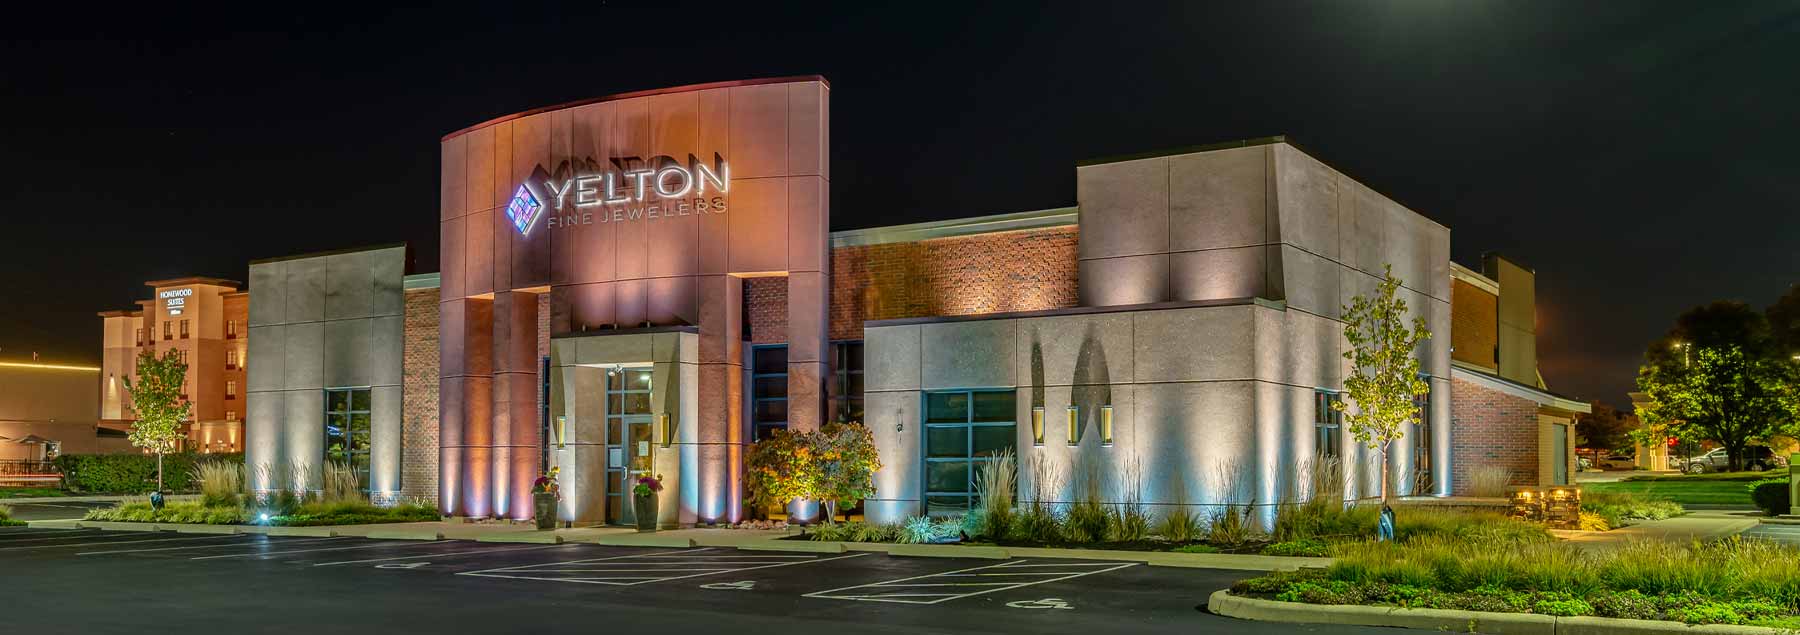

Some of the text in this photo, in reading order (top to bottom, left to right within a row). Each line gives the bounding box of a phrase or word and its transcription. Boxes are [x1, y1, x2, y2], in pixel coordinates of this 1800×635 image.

[544, 162, 729, 209] YELTON
[547, 202, 728, 229] FINE JEWELERS
[160, 289, 192, 298] HOMEWOOD
